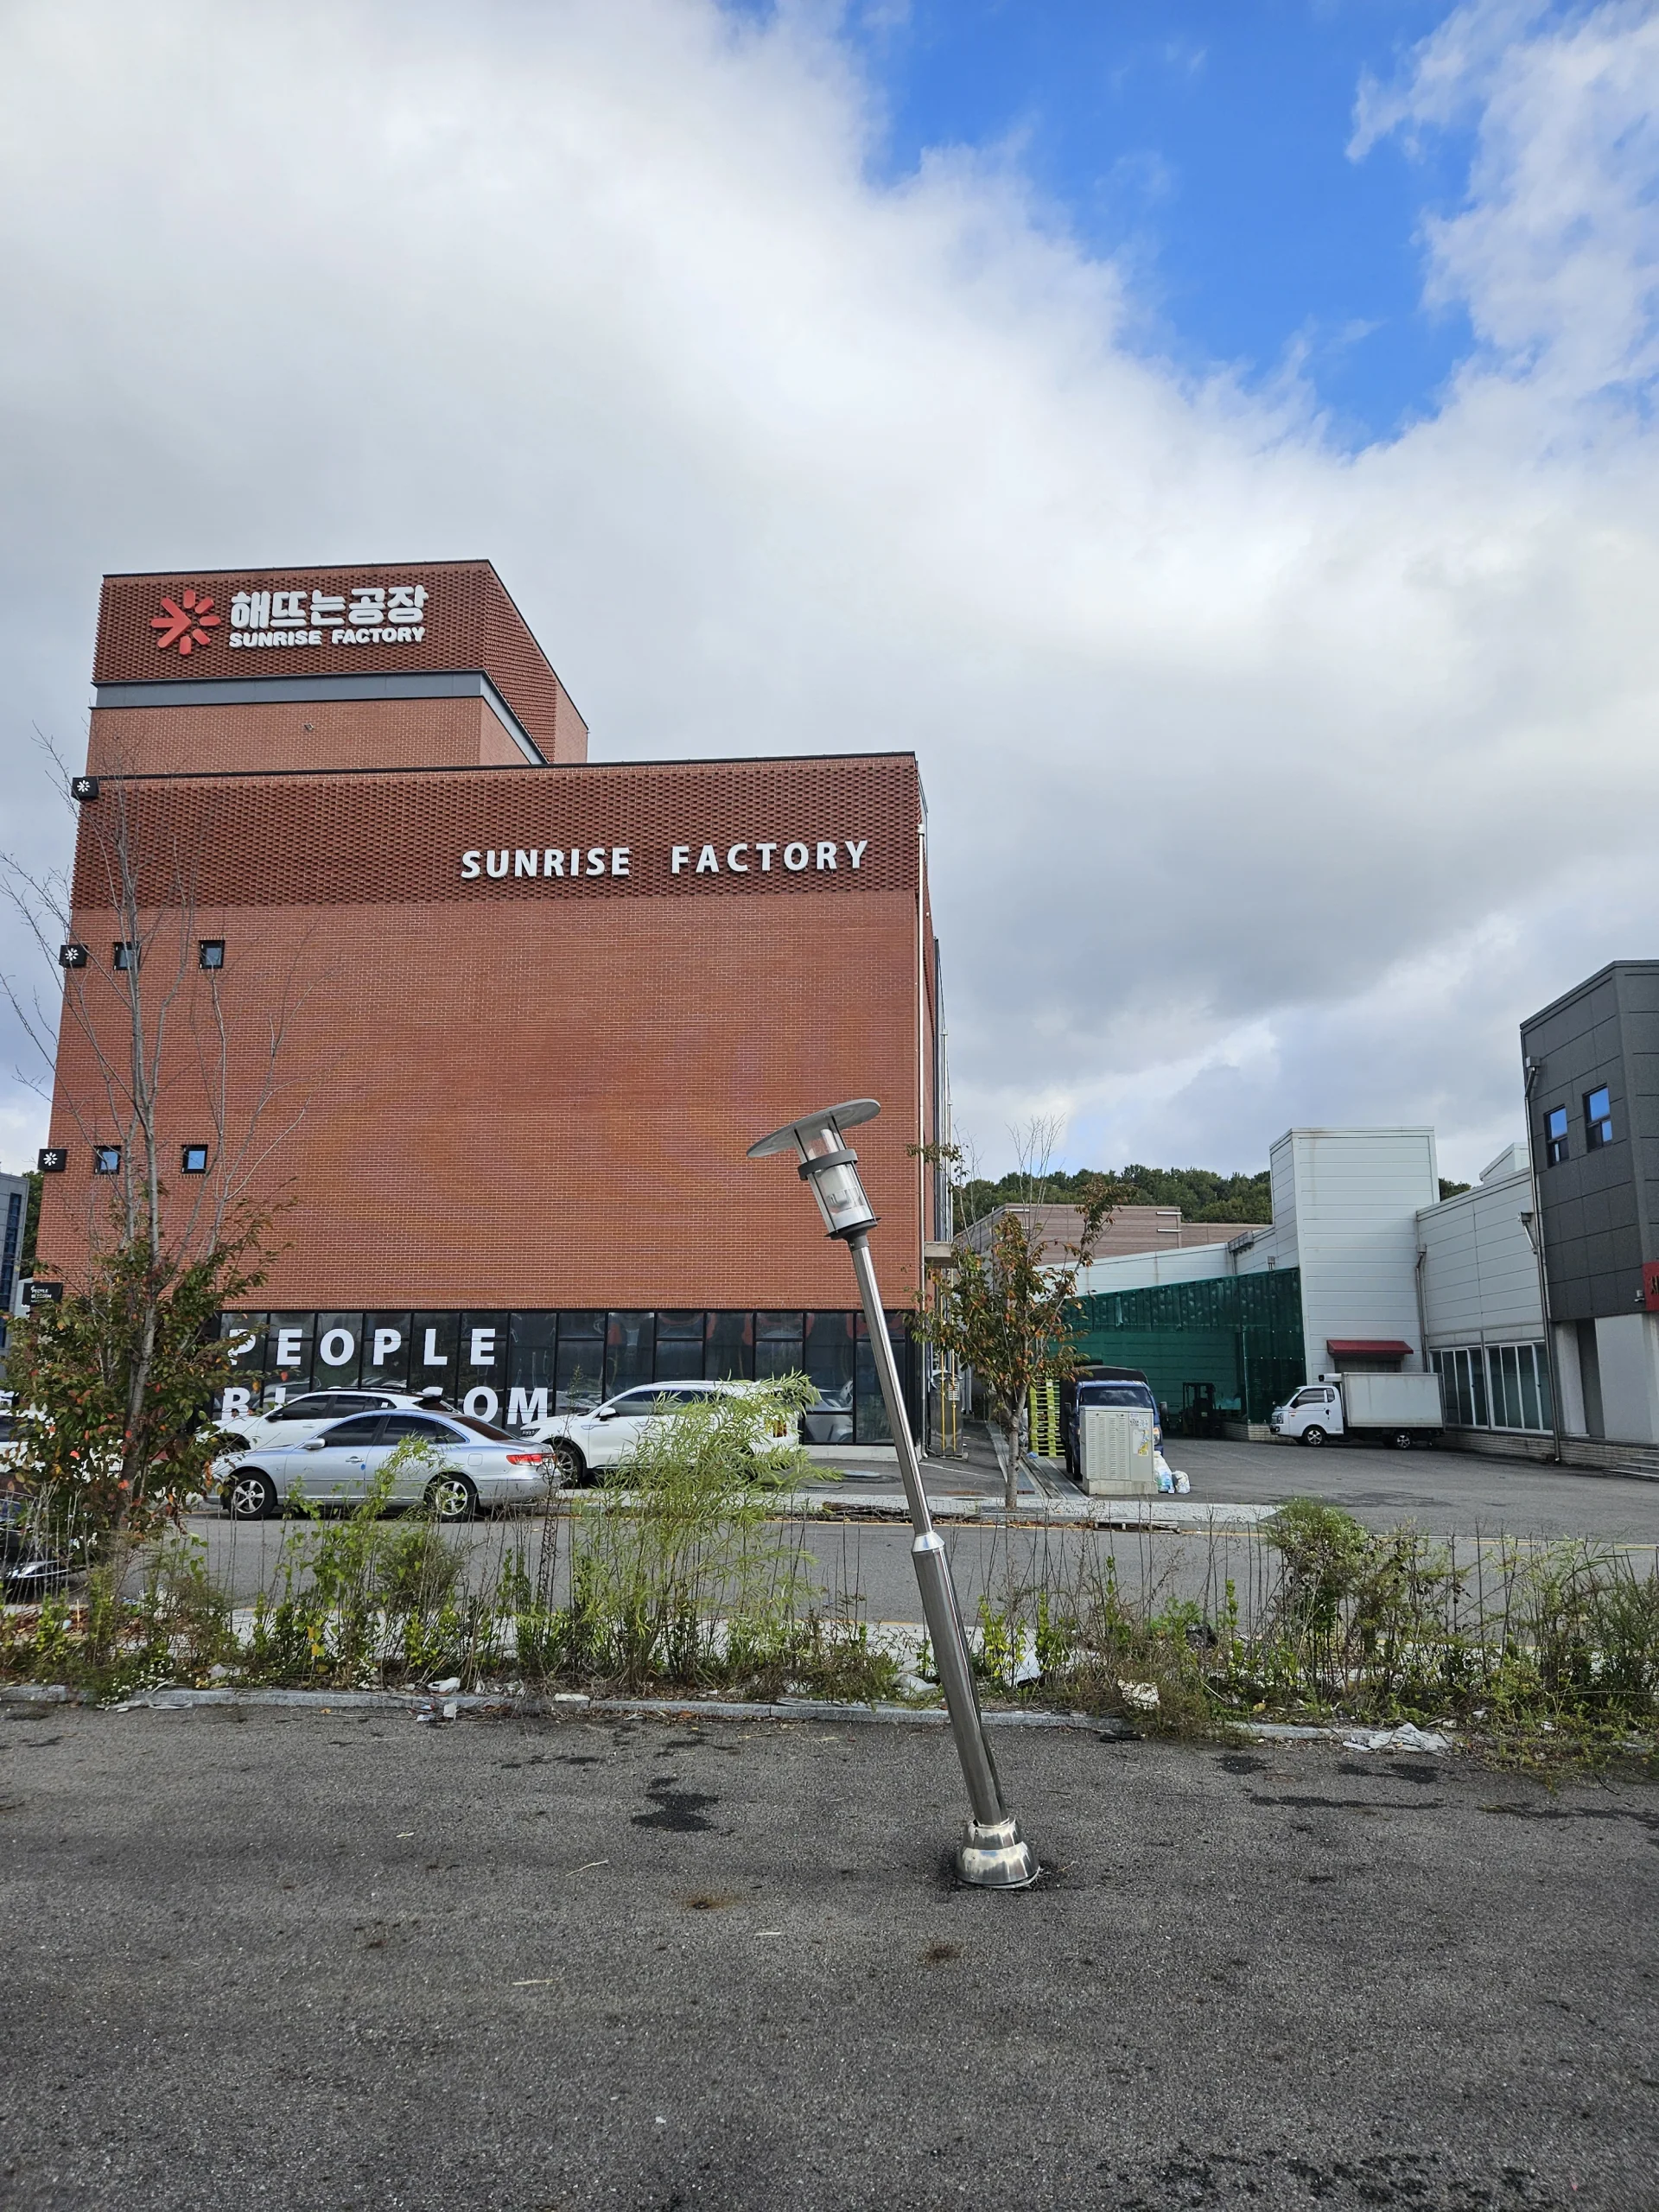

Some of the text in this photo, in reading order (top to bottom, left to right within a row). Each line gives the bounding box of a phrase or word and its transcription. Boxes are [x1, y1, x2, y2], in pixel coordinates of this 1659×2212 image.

[230, 584, 429, 628] 해뜨는공장
[229, 626, 426, 647] SUNRISE FACTORY
[461, 840, 868, 879] SUNRISE FACTORY
[227, 1328, 497, 1367] PEOPLE
